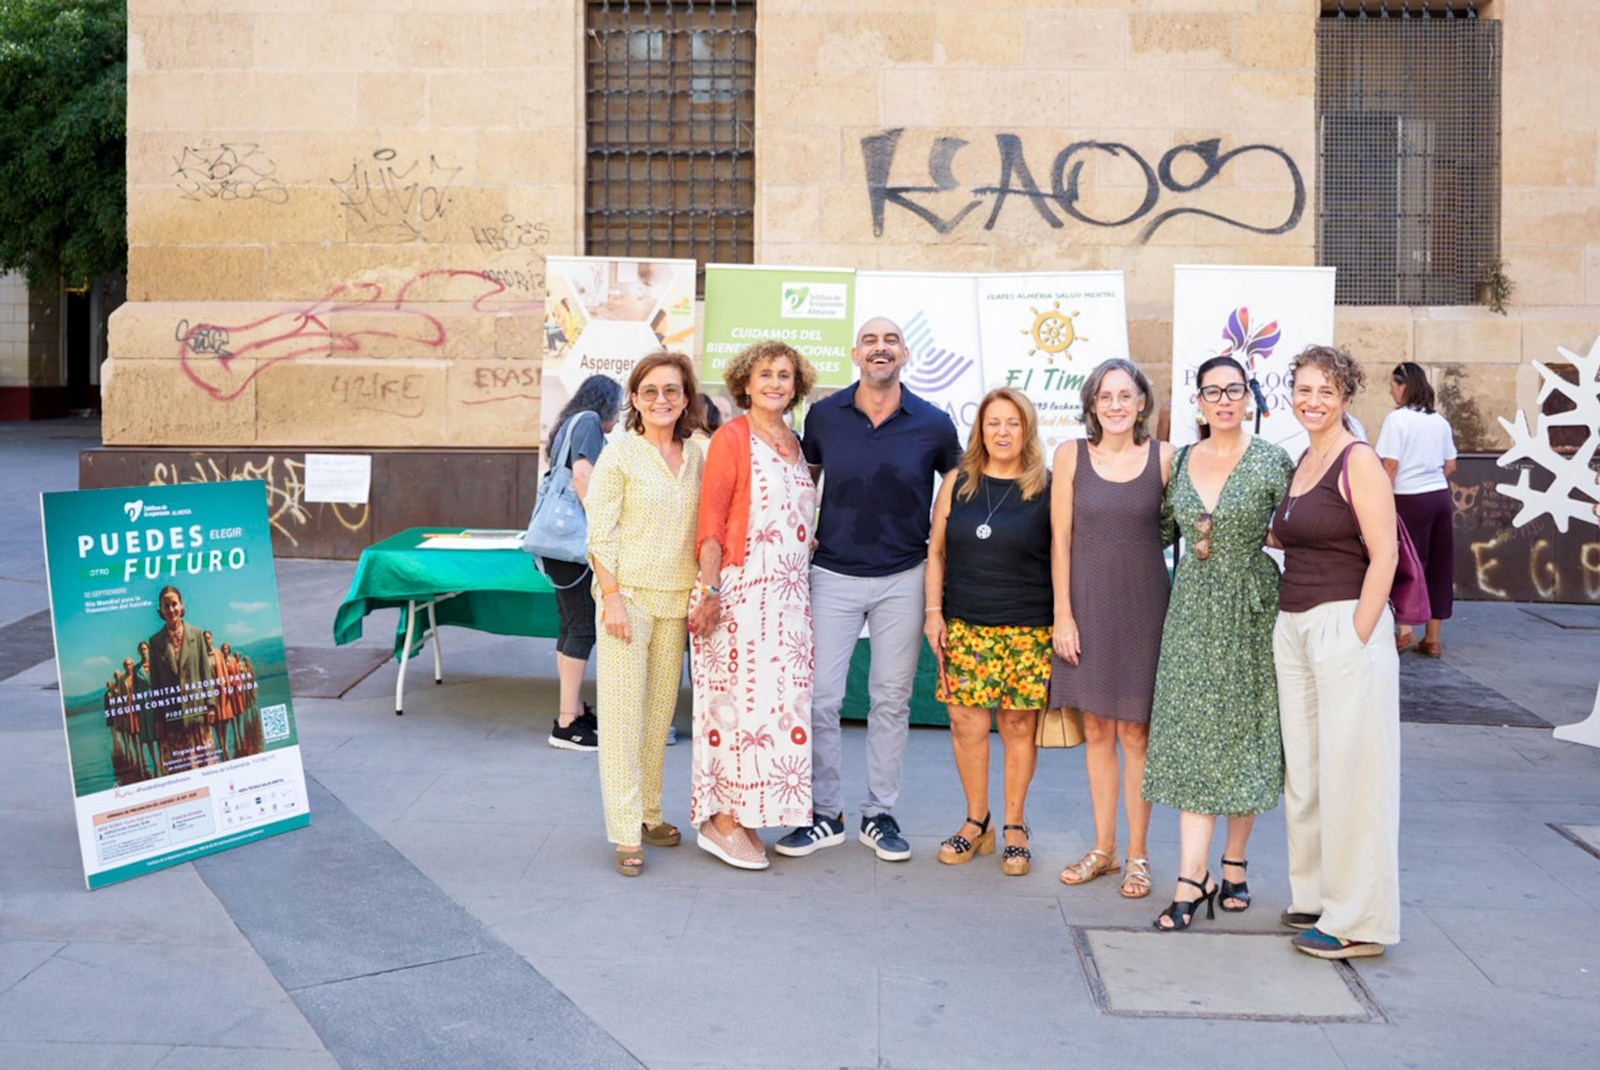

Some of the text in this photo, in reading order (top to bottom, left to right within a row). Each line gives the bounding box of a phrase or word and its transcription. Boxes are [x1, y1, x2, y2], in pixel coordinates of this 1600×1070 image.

[731, 328, 822, 341] CUIDAMOS DEL
[706, 343, 750, 354] BIENES
[580, 354, 635, 374] Asperger
[1005, 368, 1086, 391] El Tim
[78, 524, 243, 558] PUEDES ELEGIR
[89, 547, 246, 582] OTRO FUTURO
[105, 681, 259, 718] SEGUIR CONSTRUYENDO TU VIDA
[108, 672, 253, 705] HAY INFINITAS RAZONES PARA
[165, 705, 208, 719] PIDE AYUDA
